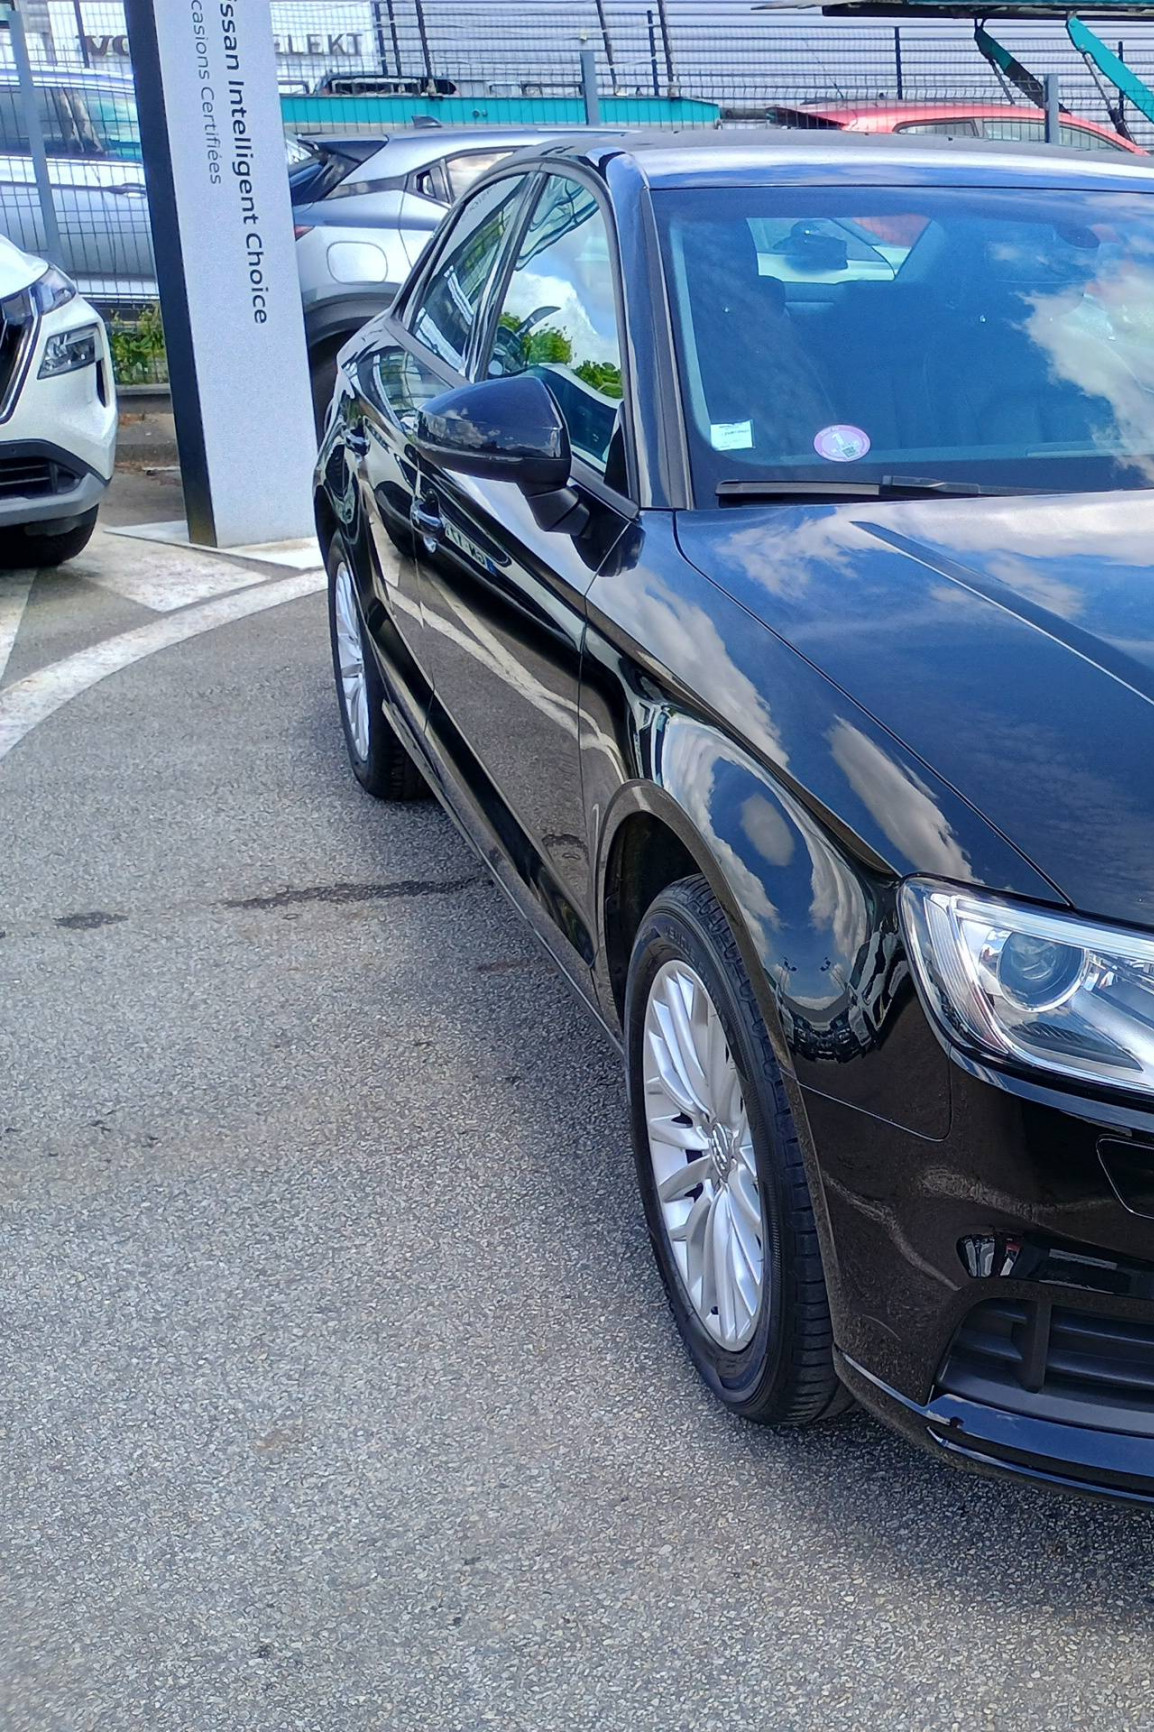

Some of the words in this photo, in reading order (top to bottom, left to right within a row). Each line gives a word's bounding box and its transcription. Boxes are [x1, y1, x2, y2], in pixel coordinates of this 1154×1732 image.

[220, 0, 240, 71] ssan
[200, 86, 222, 184] Certifiées
[228, 80, 259, 225] Intelligent
[245, 233, 269, 324] Choice
